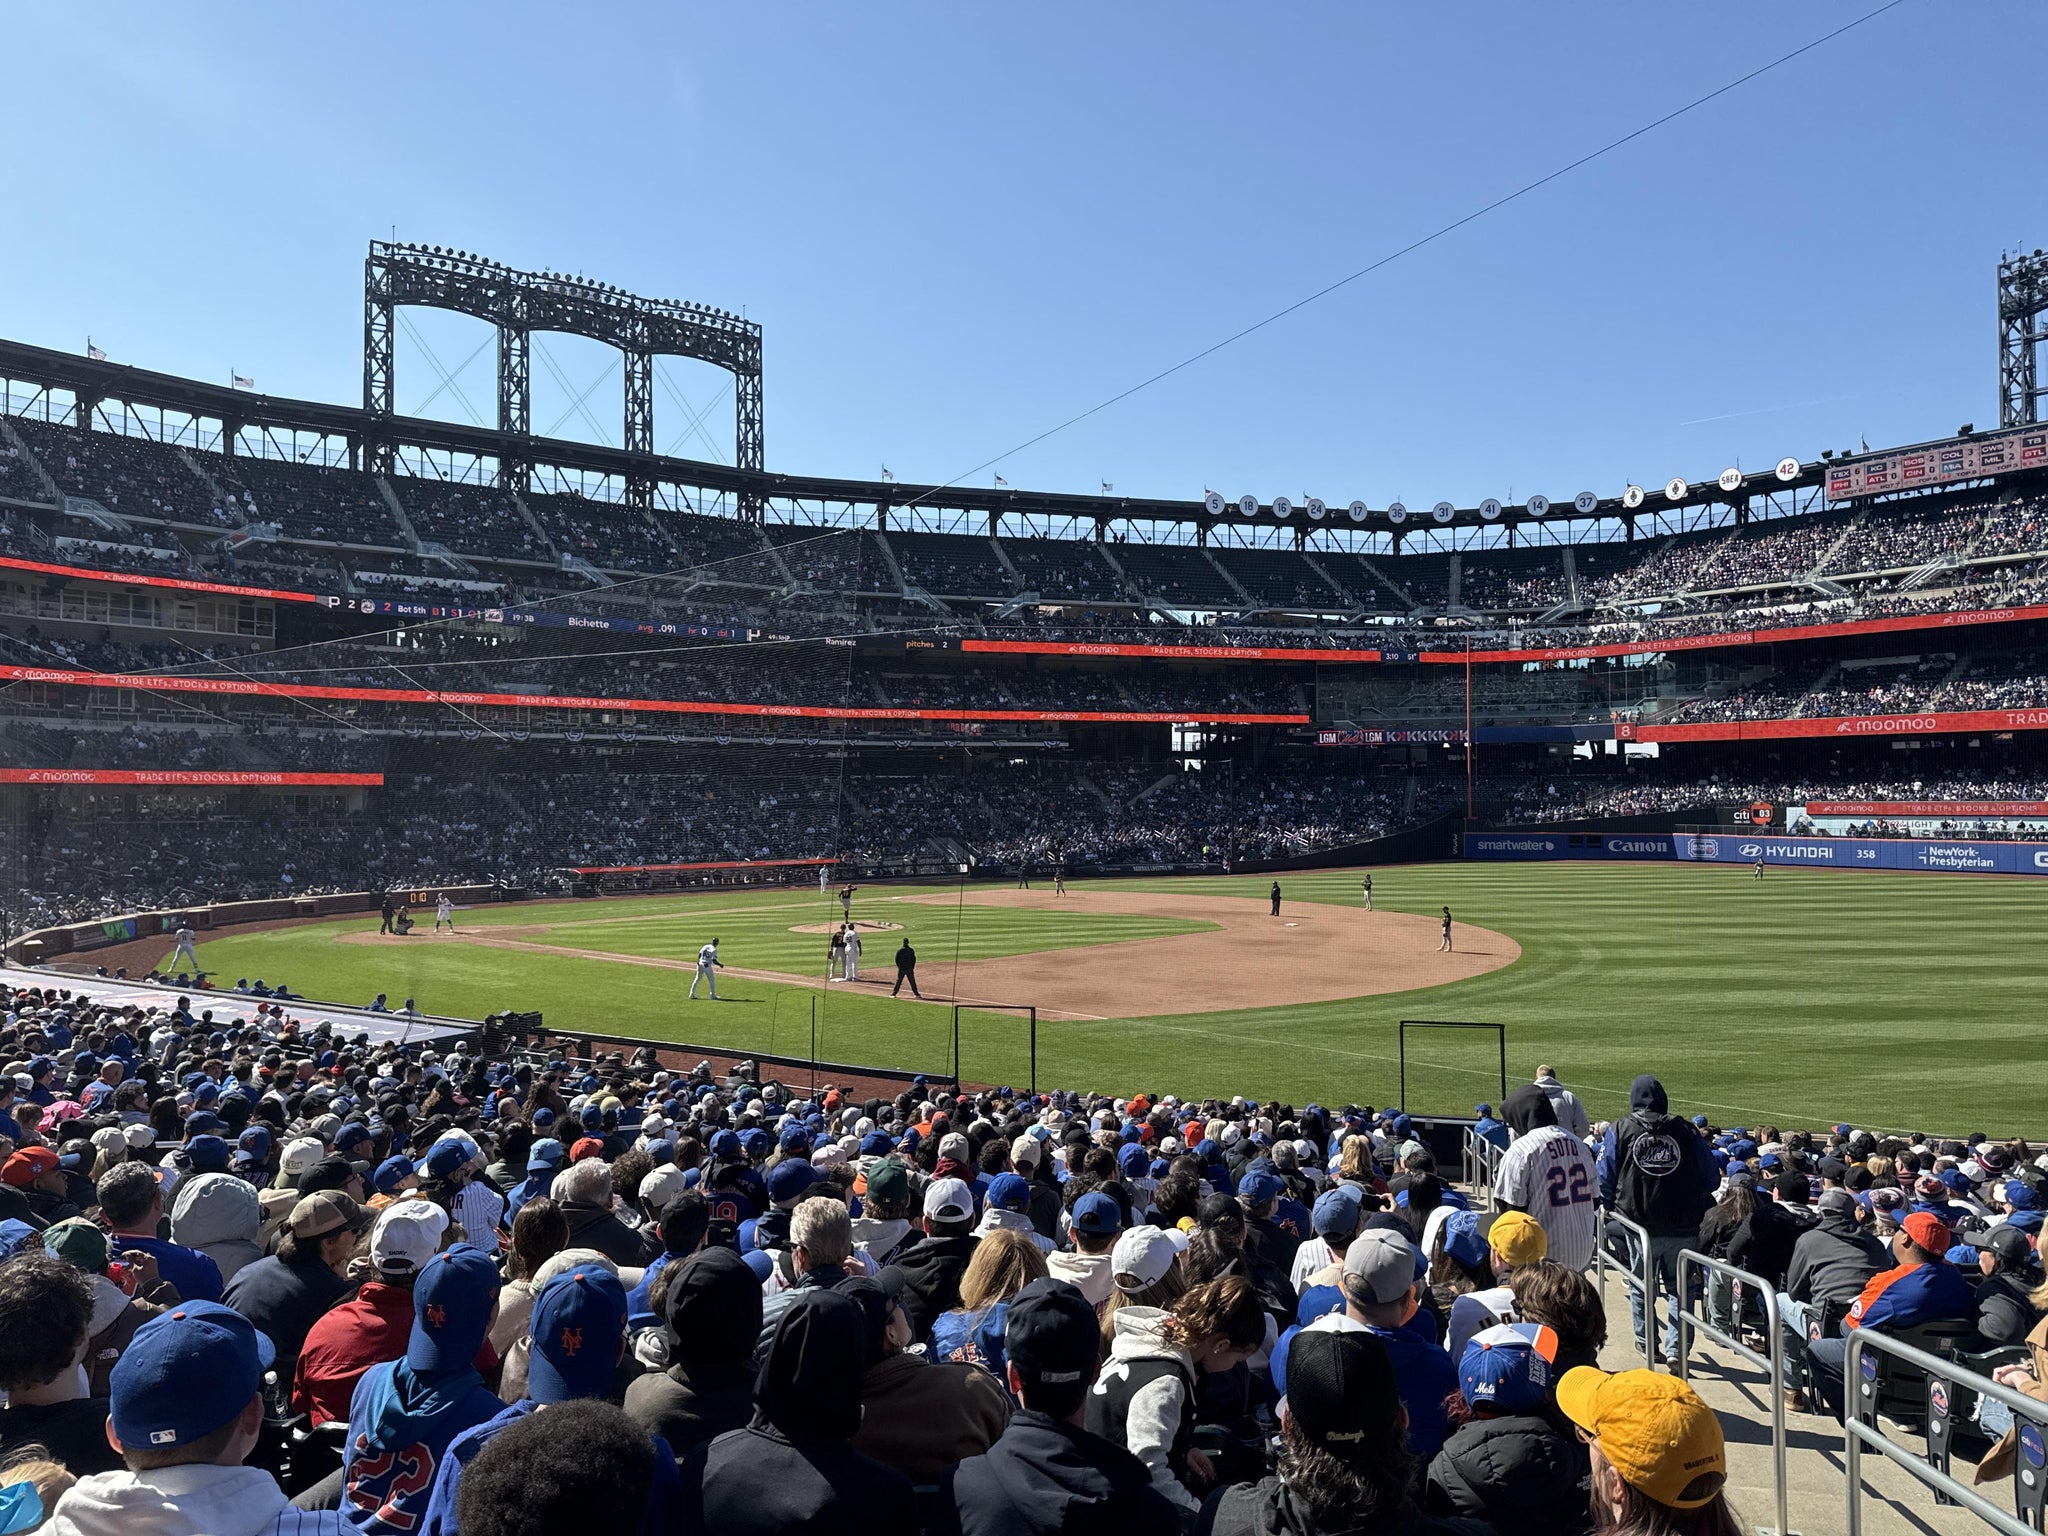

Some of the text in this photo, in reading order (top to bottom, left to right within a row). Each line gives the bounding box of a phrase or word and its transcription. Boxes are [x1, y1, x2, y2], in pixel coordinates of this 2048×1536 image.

[1942, 451, 1962, 460] COL
[2024, 449, 2044, 457] STL
[1984, 455, 2001, 464] MIL
[1780, 462, 1794, 475] 42
[1944, 462, 1962, 471] MIA
[1832, 470, 1849, 478] TEX
[1906, 469, 1923, 477] CIN
[1721, 474, 1740, 485] SHEA
[1868, 476, 1886, 484] ATL
[1833, 481, 1849, 489] PHI
[1212, 499, 1218, 509] 5
[1244, 501, 1254, 511] 18
[1278, 502, 1287, 512] 16
[1532, 500, 1544, 511] 14
[1579, 498, 1593, 508] 37
[1310, 504, 1322, 514] 24
[1354, 506, 1362, 516] 17
[1392, 508, 1402, 518] 36
[1438, 508, 1448, 518] 31
[1485, 504, 1496, 514] 41
[112, 574, 150, 584] moomoo
[348, 600, 356, 609] 2
[384, 602, 391, 611] 2
[413, 606, 426, 614] 5th
[432, 608, 440, 616] B
[450, 608, 458, 616] S
[1956, 610, 2015, 624] moomoo
[568, 617, 610, 628] Bichette
[638, 624, 654, 634] avg
[658, 624, 676, 634] .091
[701, 627, 707, 636] 0
[825, 638, 856, 646] Ramirez
[906, 640, 934, 650] pitches
[1628, 642, 1653, 652] TRADE
[1677, 637, 1708, 648] STOCKS
[1717, 633, 1752, 644] OPTIONS
[1078, 645, 1120, 654] moomoo
[1150, 647, 1173, 655] TRADE
[1194, 648, 1223, 656] STOCKS
[1231, 648, 1262, 657] OPTIONS
[1556, 648, 1598, 658] moomoo
[26, 670, 75, 682] moomoo
[114, 677, 145, 687] TRADE
[173, 680, 210, 690] STOCKS
[220, 682, 259, 692] OPTIONS
[440, 694, 483, 703] moomoo
[516, 696, 539, 704] TRADE
[561, 698, 590, 706] STOCKS
[598, 699, 630, 708] OPTIONS
[1856, 717, 1936, 732] moomoo
[1620, 726, 1630, 737] 8
[1320, 732, 1382, 743] LGM LGM
[42, 772, 96, 782] moomoo
[135, 773, 165, 782] TRADE
[193, 774, 231, 782] STOCKS
[241, 774, 283, 783] OPTIONS
[1733, 808, 1750, 820] citi
[1759, 809, 1770, 818] 03
[1478, 840, 1544, 851] smartwater
[1608, 839, 1668, 852] Canon
[1766, 846, 1833, 859] HYUNDAI
[1856, 850, 1876, 859] 358
[1929, 846, 1980, 857] NewYork-
[1930, 856, 1994, 869] Presbyterian
[1546, 1138, 1579, 1160] SOTO
[1641, 1146, 1671, 1162] Mets
[1546, 1163, 1592, 1208] 22
[1474, 1382, 1496, 1394] Mets
[2021, 1434, 2031, 1448] citi
[346, 1434, 436, 1531] 22
